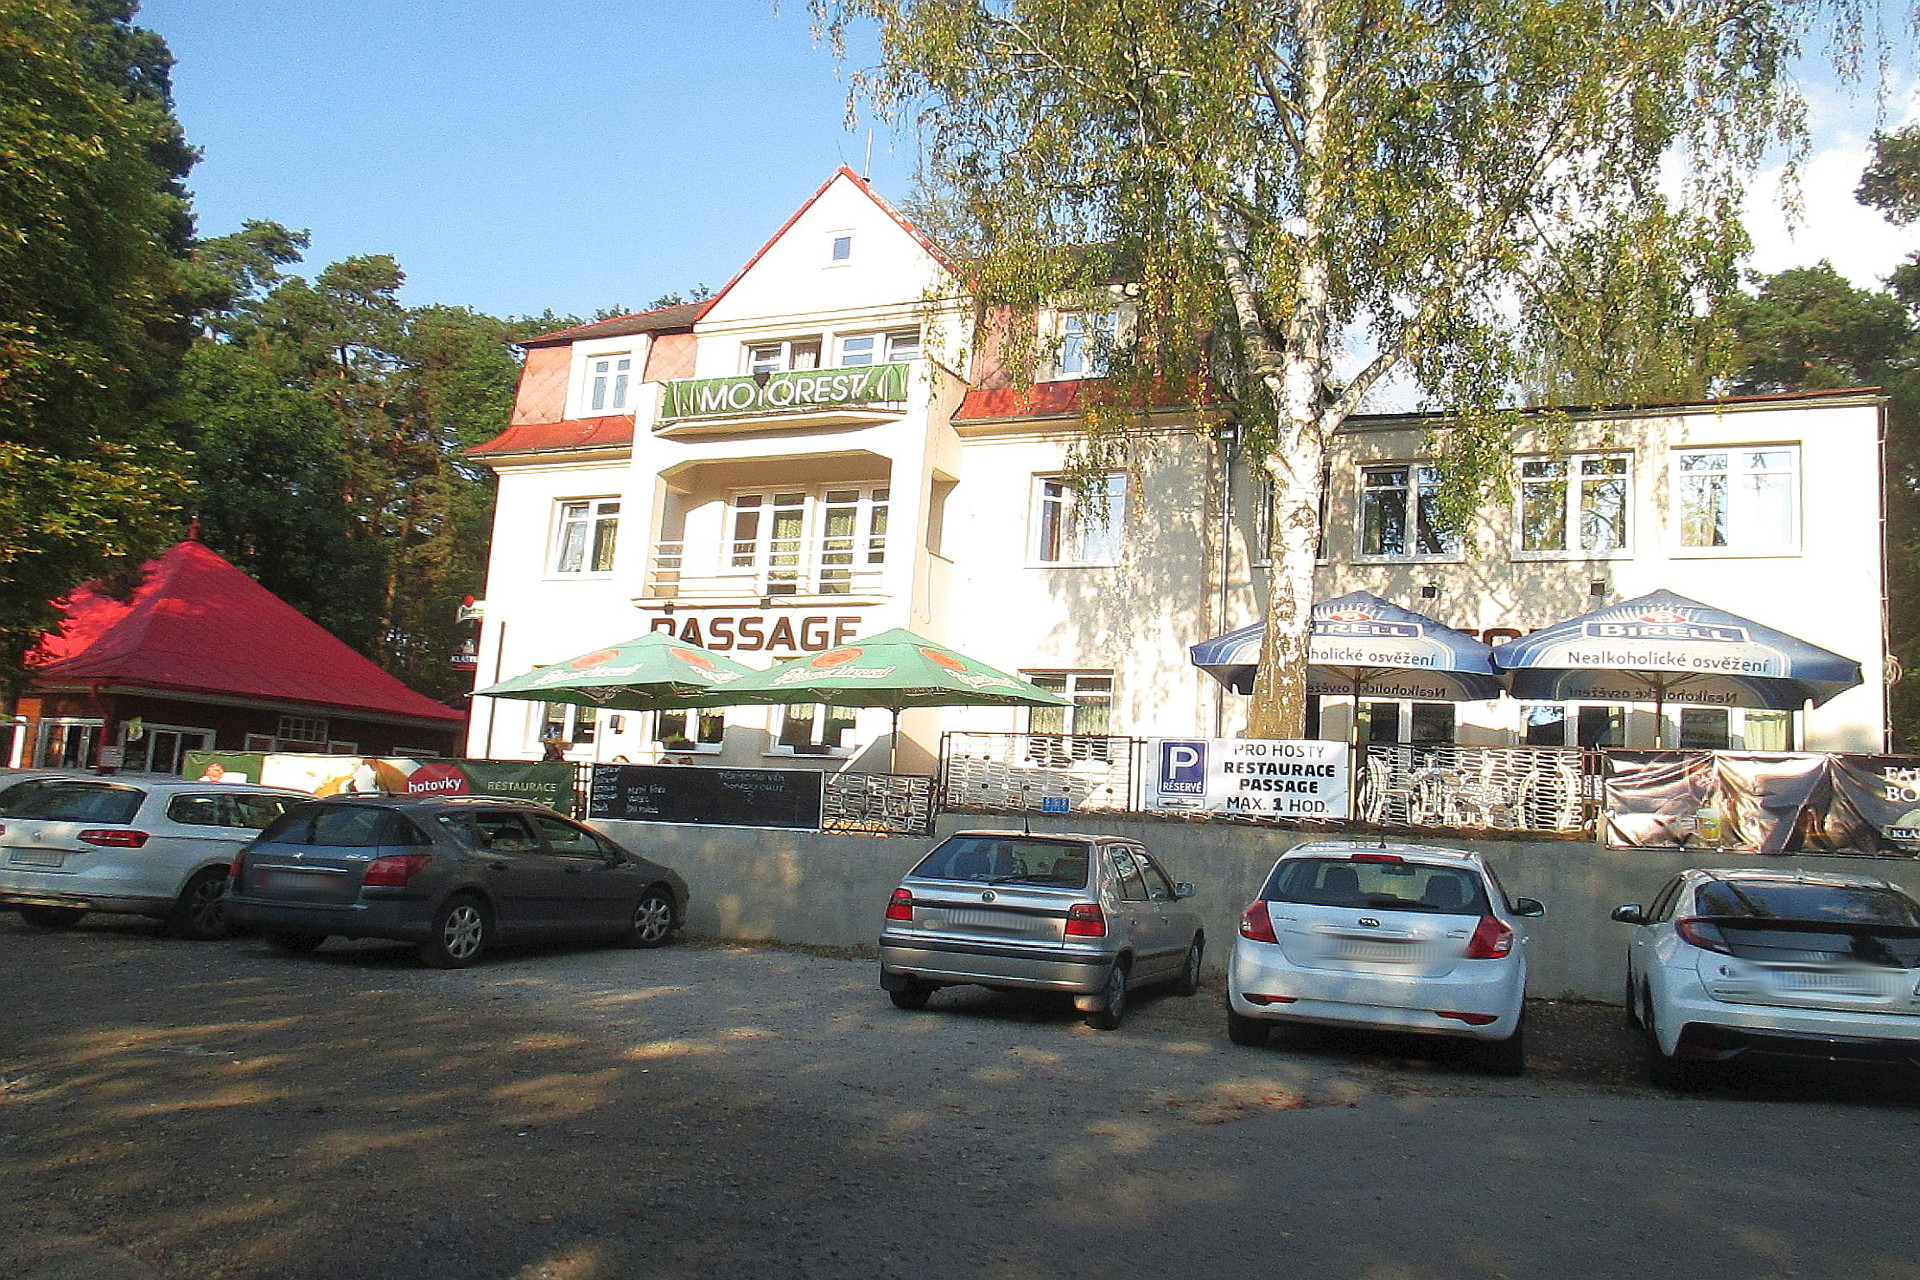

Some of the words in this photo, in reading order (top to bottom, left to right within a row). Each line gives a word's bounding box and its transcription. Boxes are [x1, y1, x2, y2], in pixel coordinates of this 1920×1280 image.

[651, 616, 862, 651] PASSAGE
[1311, 624, 1410, 637] IRELL
[1600, 624, 1734, 641] BIRELL
[1369, 651, 1436, 666] osvěžení
[1567, 651, 1686, 667] Nealkoholické
[1693, 655, 1769, 673] osvěžení
[1234, 743, 1267, 756] PRO
[1272, 745, 1325, 758] HOSTY
[1169, 746, 1198, 779] P
[1224, 761, 1335, 778] RESTAURACE
[408, 777, 462, 793] hotovky
[487, 781, 557, 792] RESTAURACE
[1239, 778, 1318, 793] PASSAGE
[1226, 796, 1267, 811] MAX.
[1272, 798, 1283, 811] 1
[1289, 799, 1330, 813] HOD.
